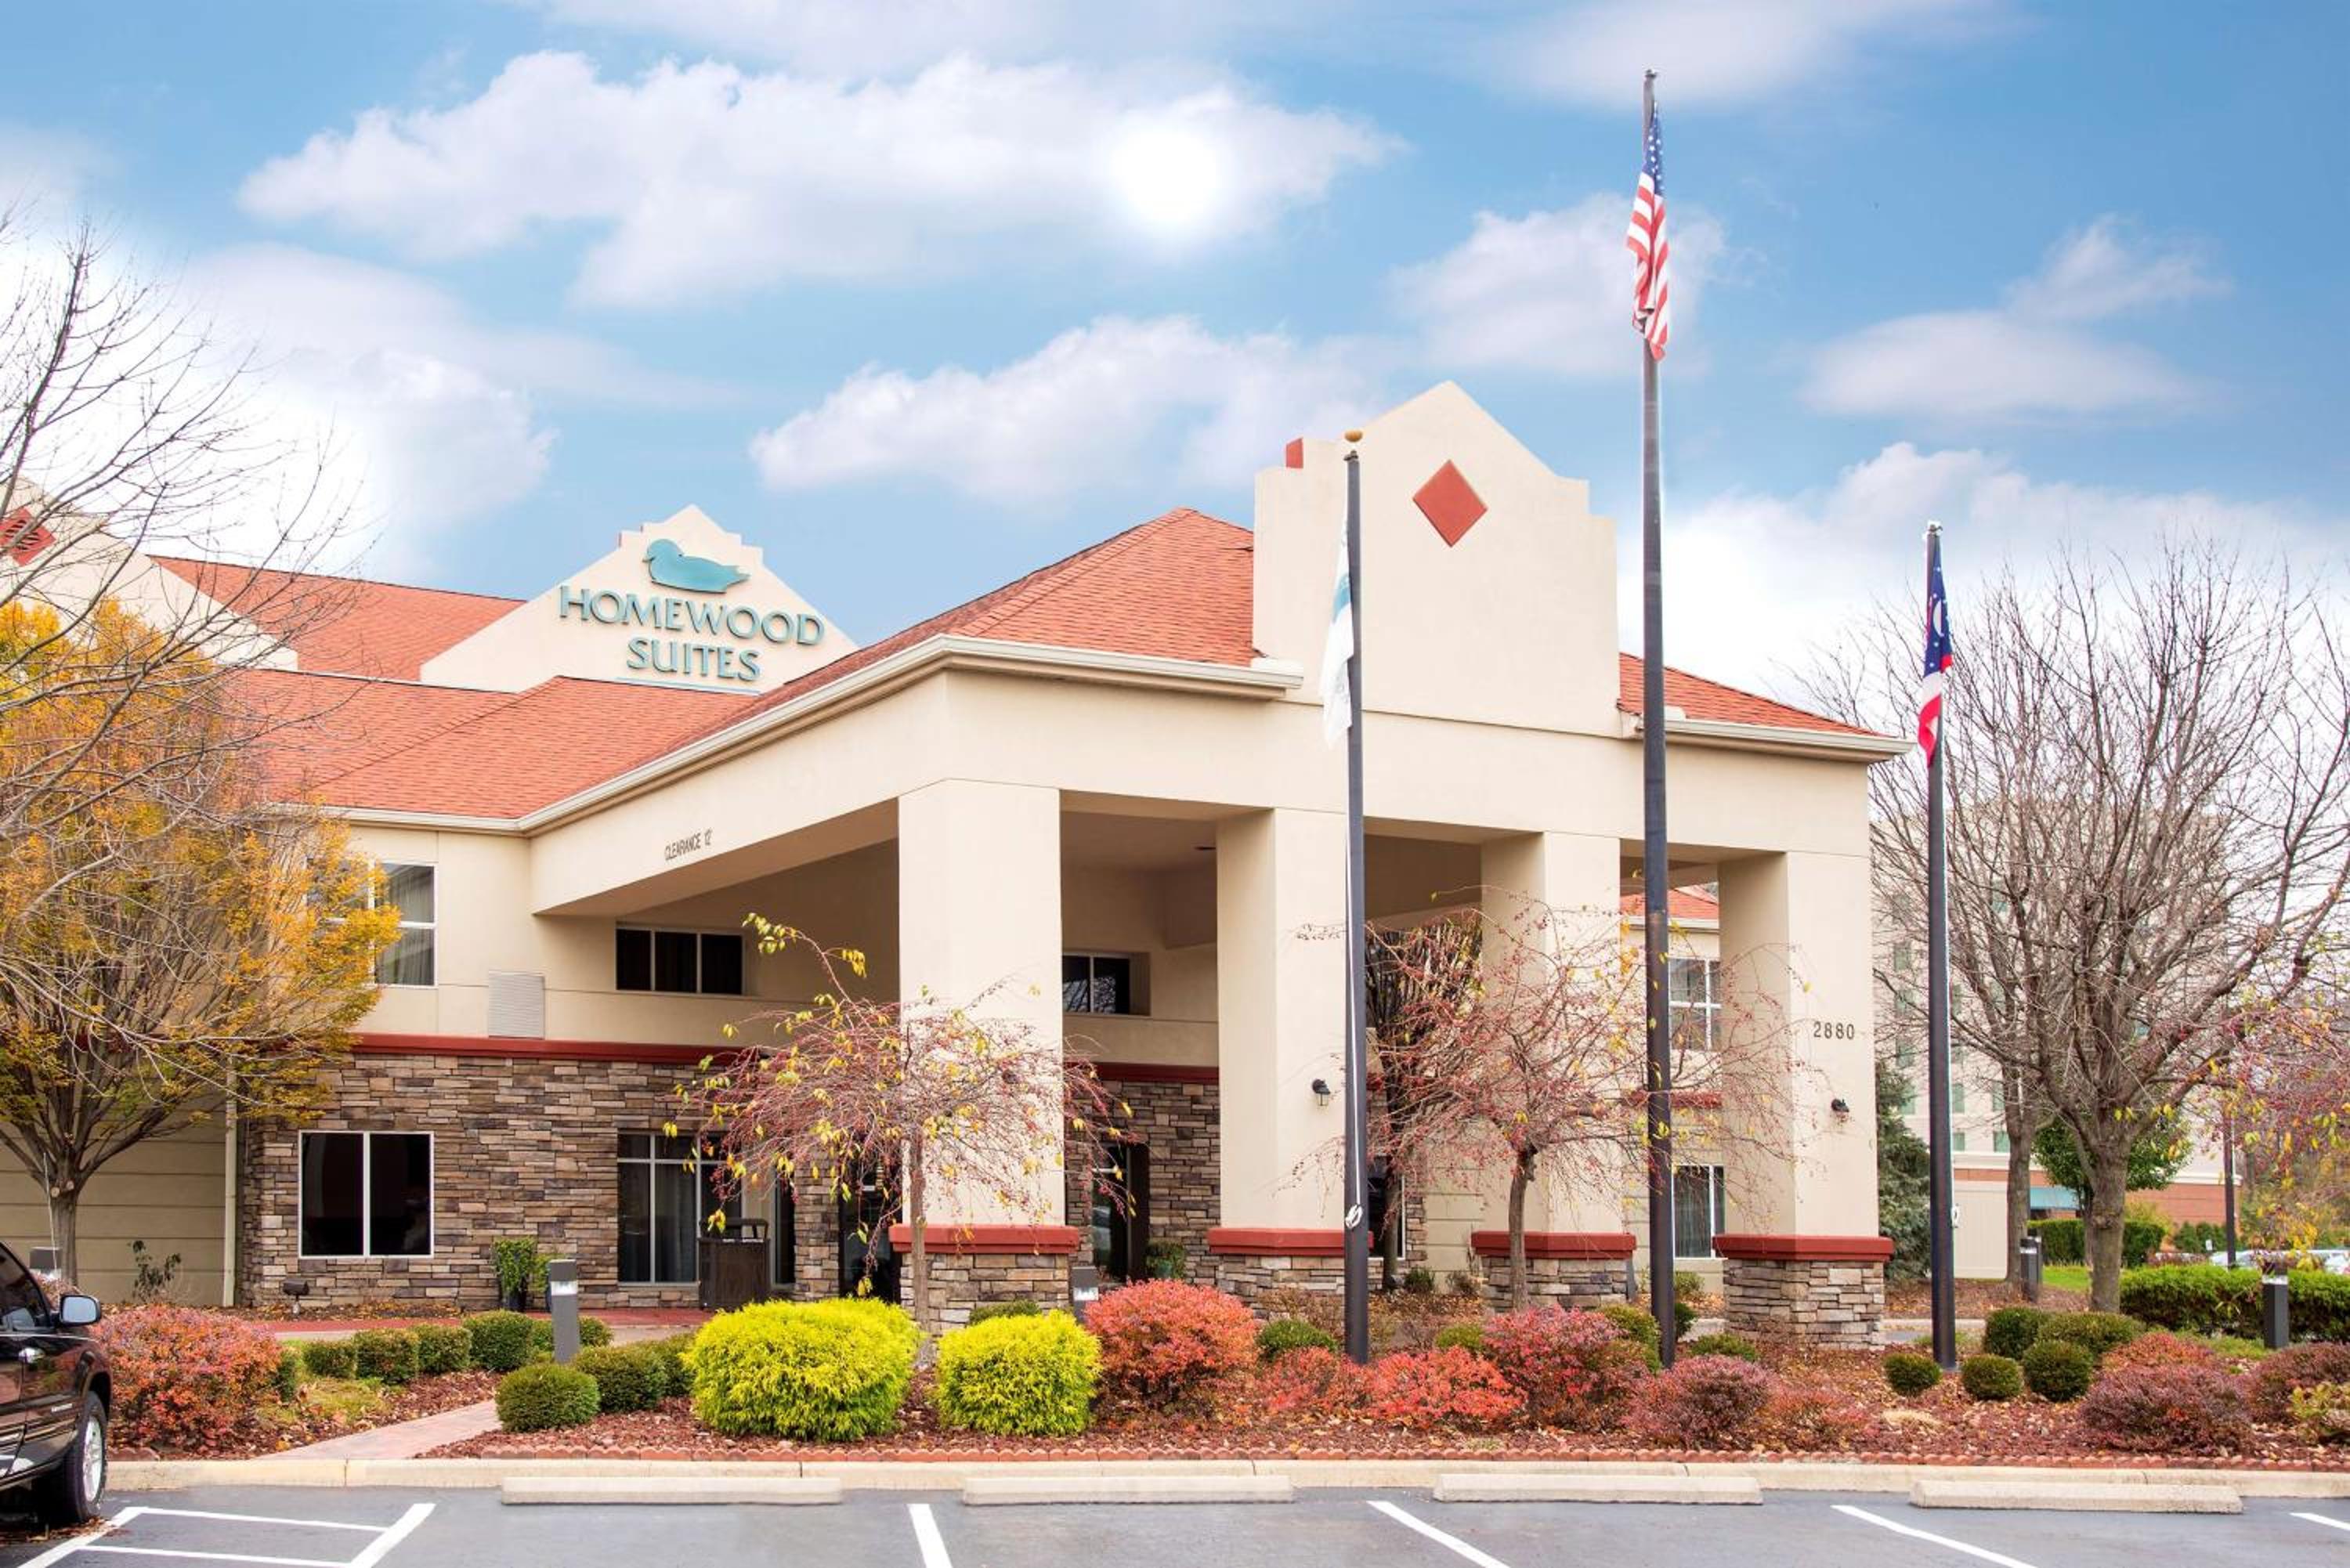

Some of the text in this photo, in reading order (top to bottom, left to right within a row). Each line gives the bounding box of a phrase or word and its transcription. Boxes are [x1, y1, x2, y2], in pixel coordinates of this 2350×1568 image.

[559, 585, 825, 645] HOMEWOOD
[627, 638, 761, 681] SUITES
[664, 832, 702, 861] CLEARANCE
[1813, 1021, 1855, 1040] 2880
